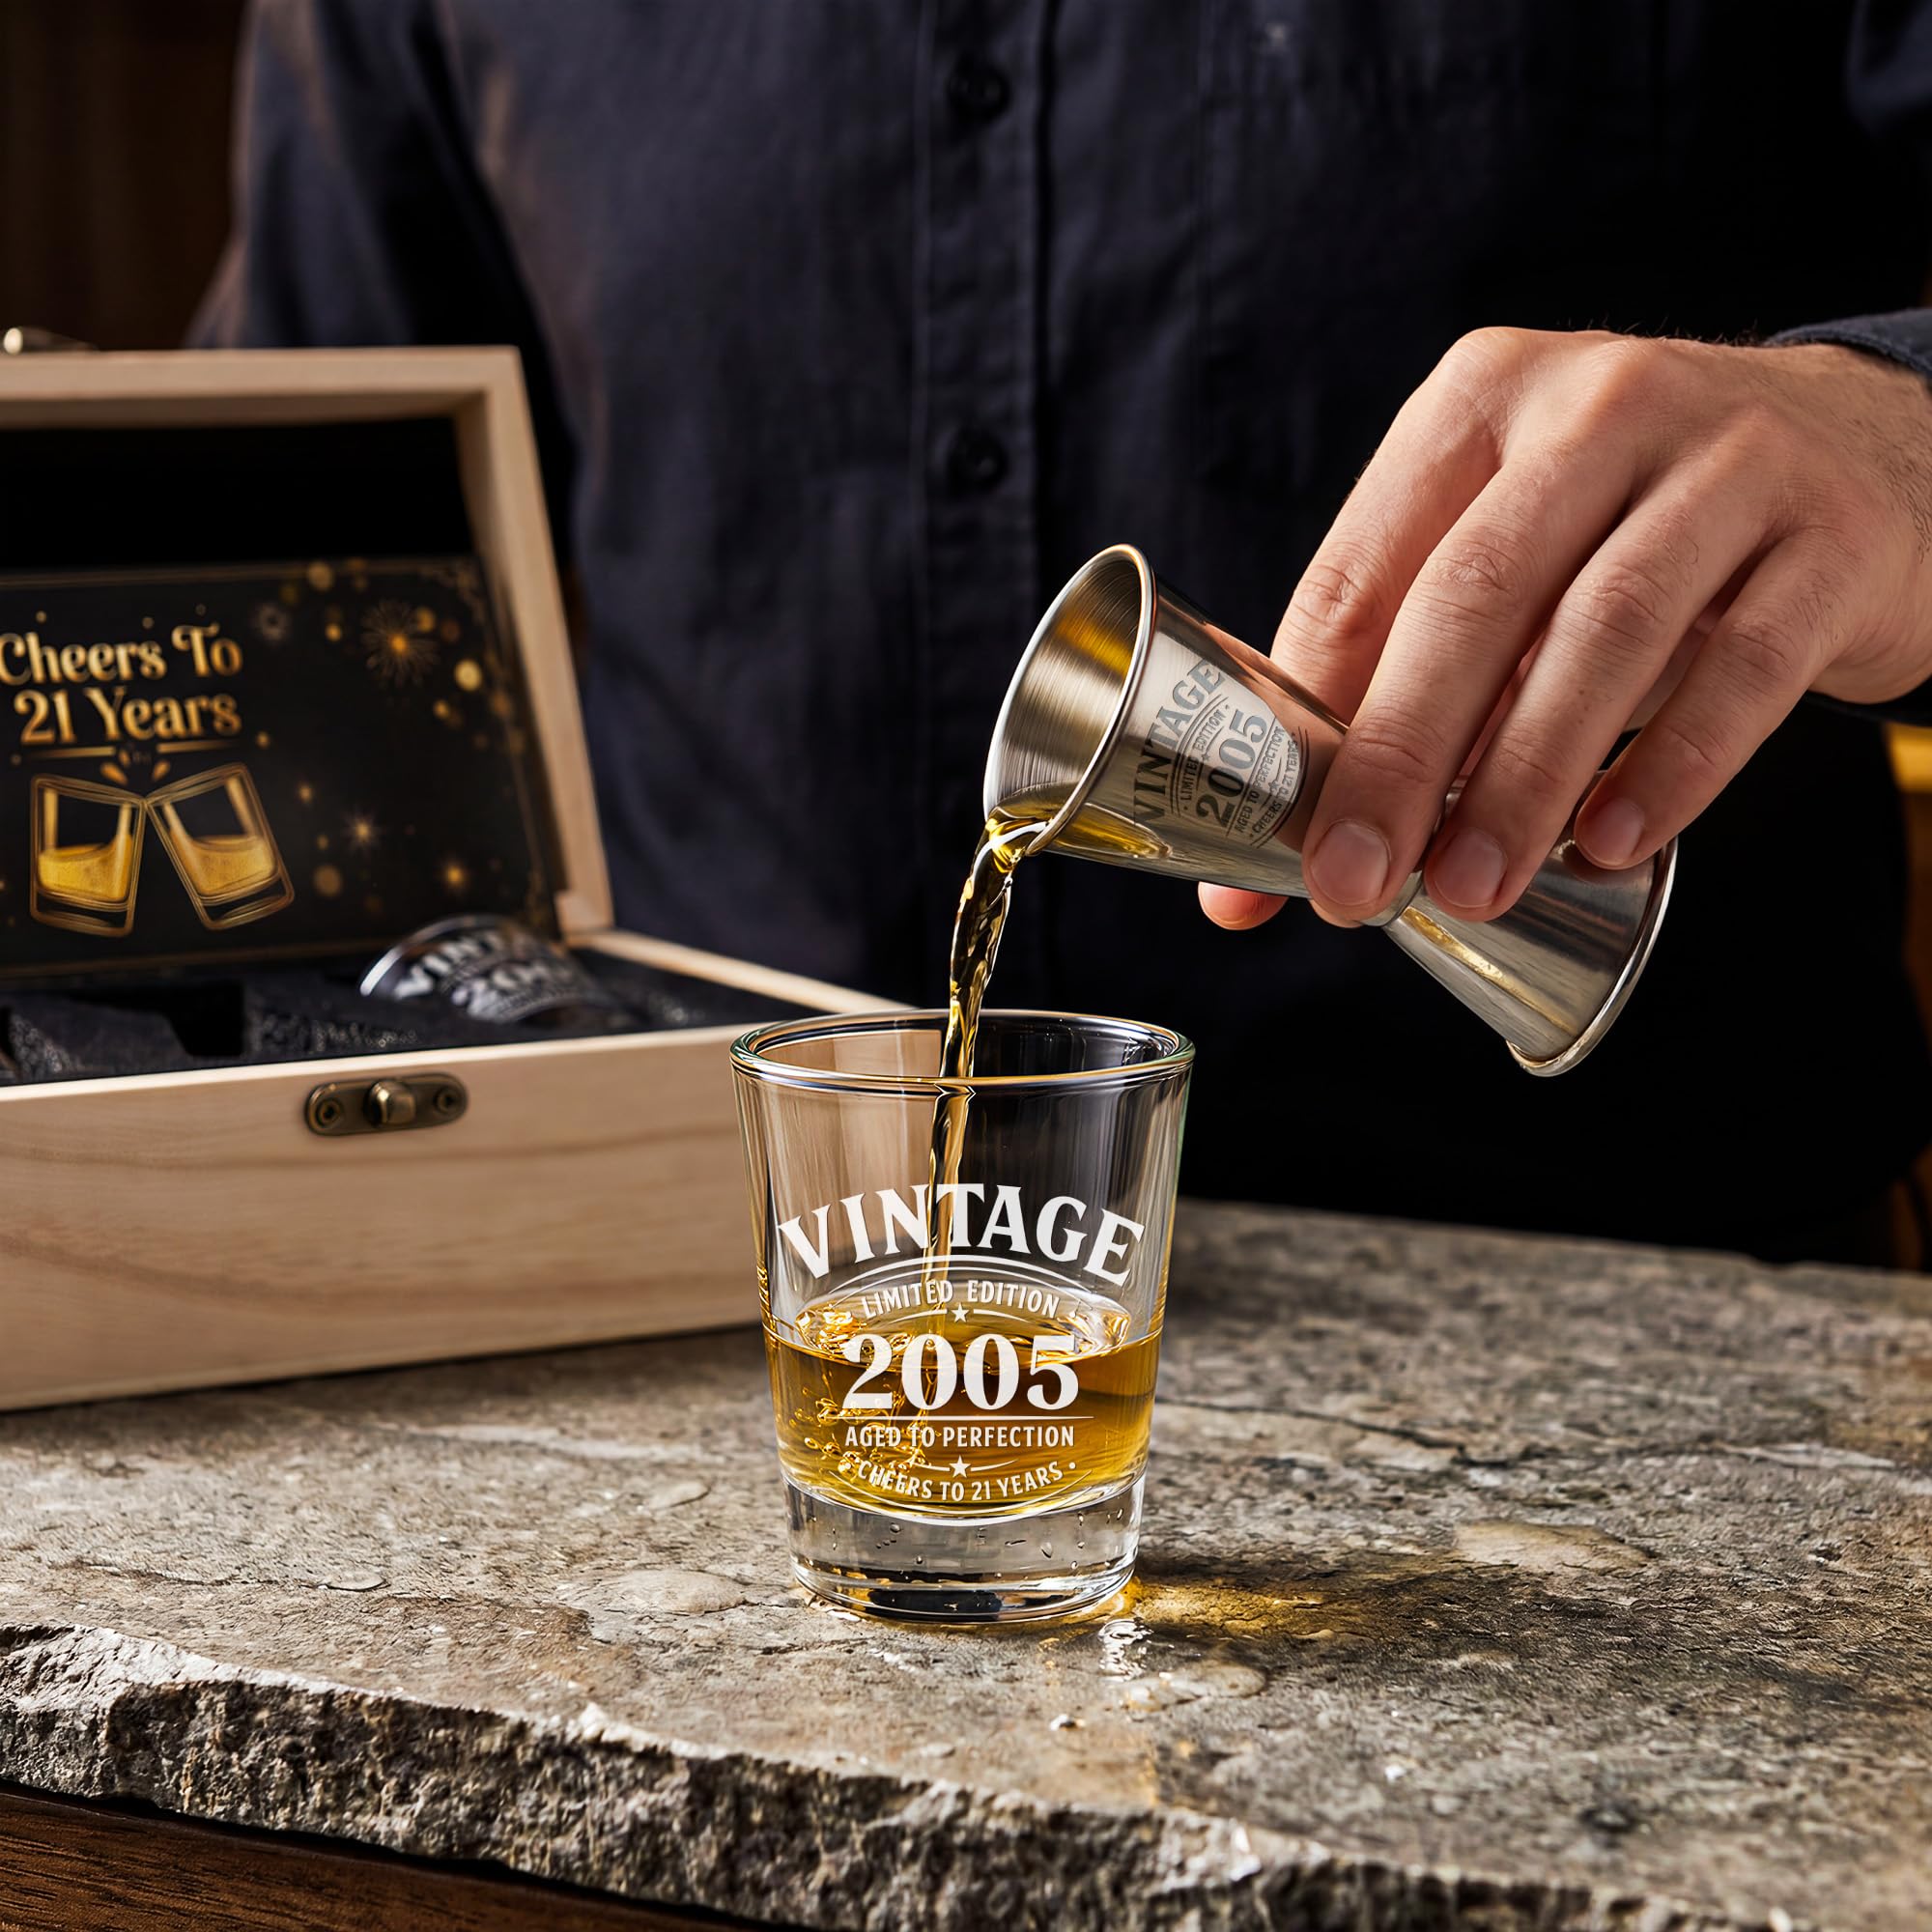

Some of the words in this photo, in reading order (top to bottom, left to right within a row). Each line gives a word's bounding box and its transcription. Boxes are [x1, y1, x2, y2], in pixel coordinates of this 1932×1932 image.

[0, 632, 167, 685] Cheers
[171, 622, 242, 676] To
[14, 689, 75, 744] 21
[83, 686, 242, 740] Years
[1133, 659, 1227, 826] VINTAGE
[1180, 755, 1200, 801] LIMITED
[1195, 709, 1268, 828] 2005
[777, 1182, 1146, 1287] VINTAGE
[861, 1279, 954, 1319] LIMITED
[967, 1279, 1061, 1319] EDITION
[840, 1332, 1080, 1411] 2005
[844, 1426, 901, 1448] AGED
[910, 1426, 936, 1448] TO
[943, 1425, 1075, 1448] PERFECTION
[857, 1461, 933, 1500] CHEERS
[939, 1481, 965, 1502] TO
[971, 1480, 992, 1501] 21
[996, 1460, 1064, 1498] YEARS
